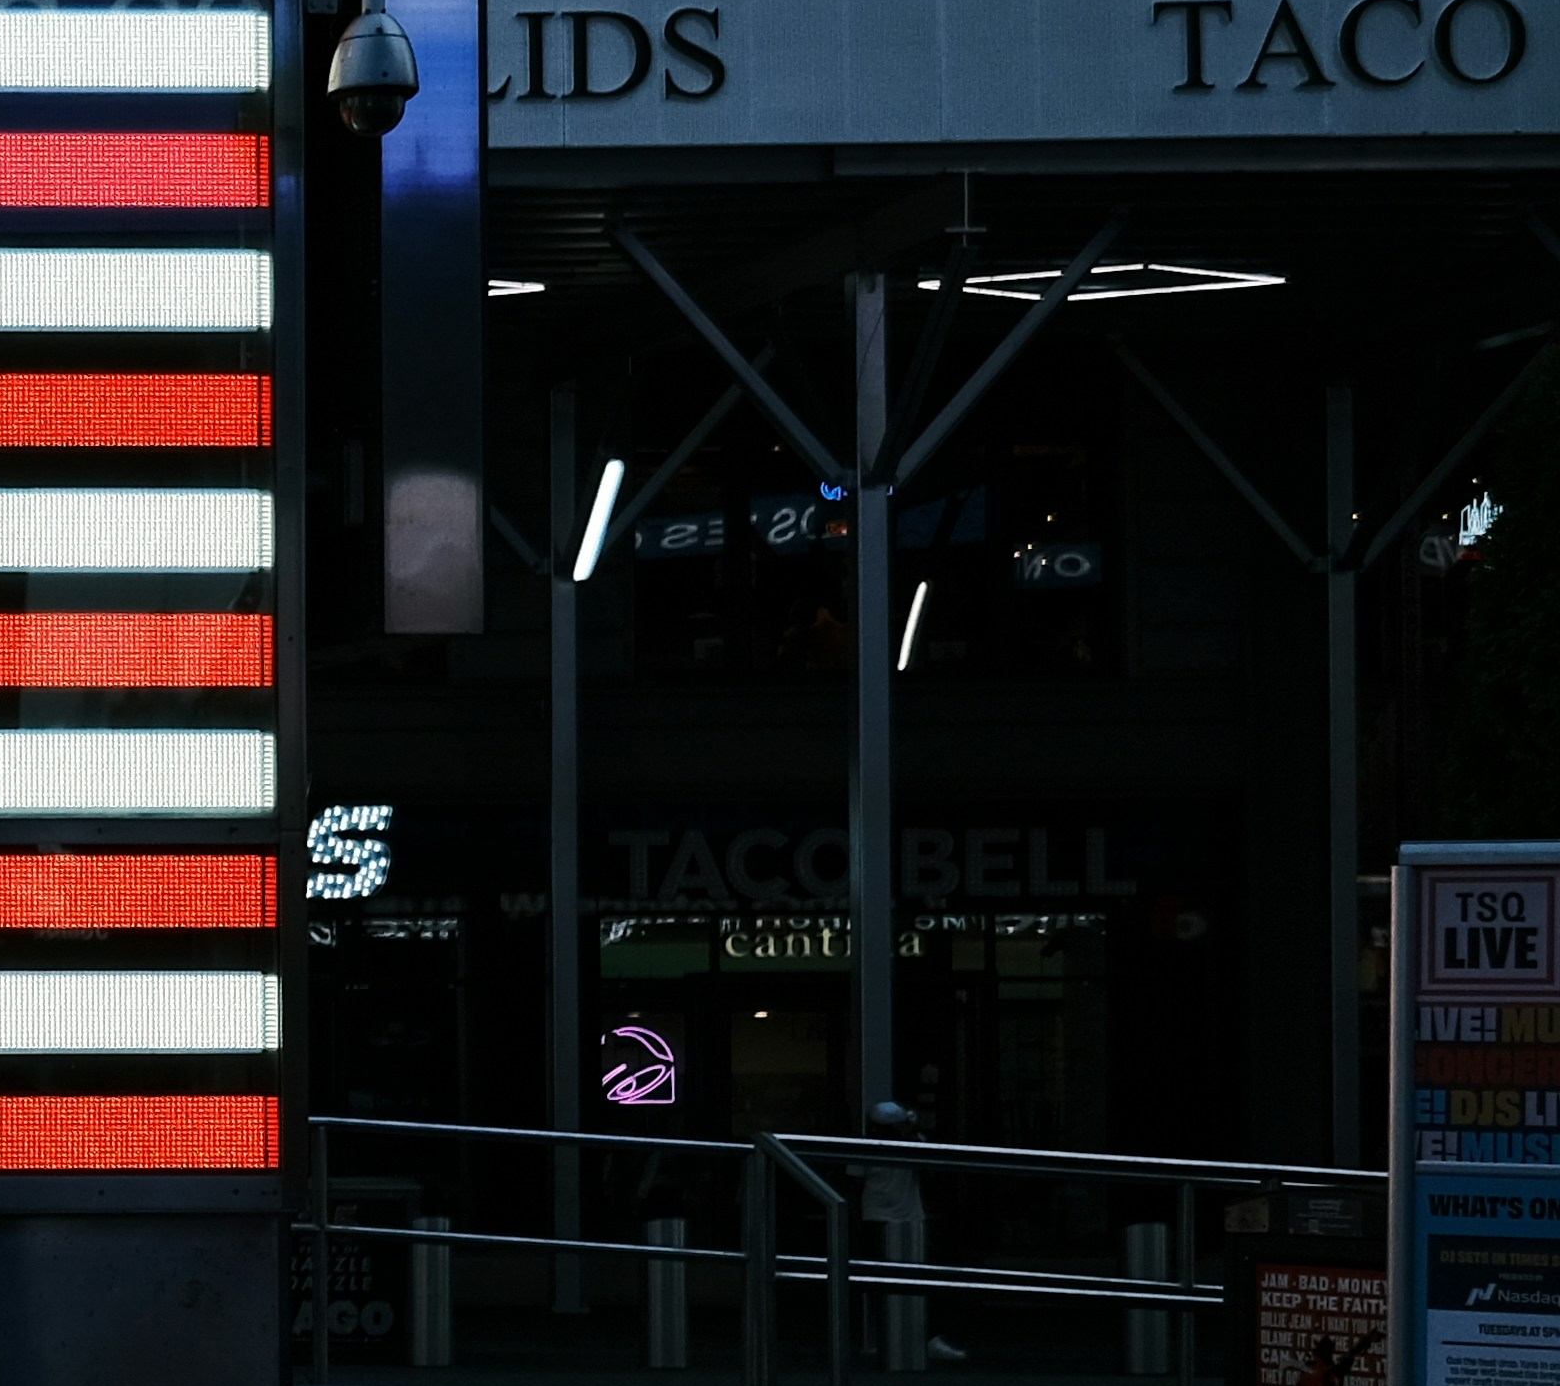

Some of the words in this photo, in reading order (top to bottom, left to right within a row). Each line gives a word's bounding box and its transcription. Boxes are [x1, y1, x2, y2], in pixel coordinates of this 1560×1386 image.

[608, 826, 851, 903] TACO
[900, 826, 1138, 900] BELL
[1455, 892, 1526, 923] TSQ
[1444, 927, 1538, 969] LIVE
[1415, 1007, 1497, 1042] IVE!
[1450, 1090, 1521, 1127] DJS
[1429, 1194, 1523, 1219] WHAT'S
[1261, 1272, 1289, 1289] JAM
[1298, 1274, 1329, 1291] BAD
[1261, 1291, 1302, 1308] KEEP
[1306, 1294, 1338, 1311] THE
[1497, 1289, 1560, 1308] Nasdaq
